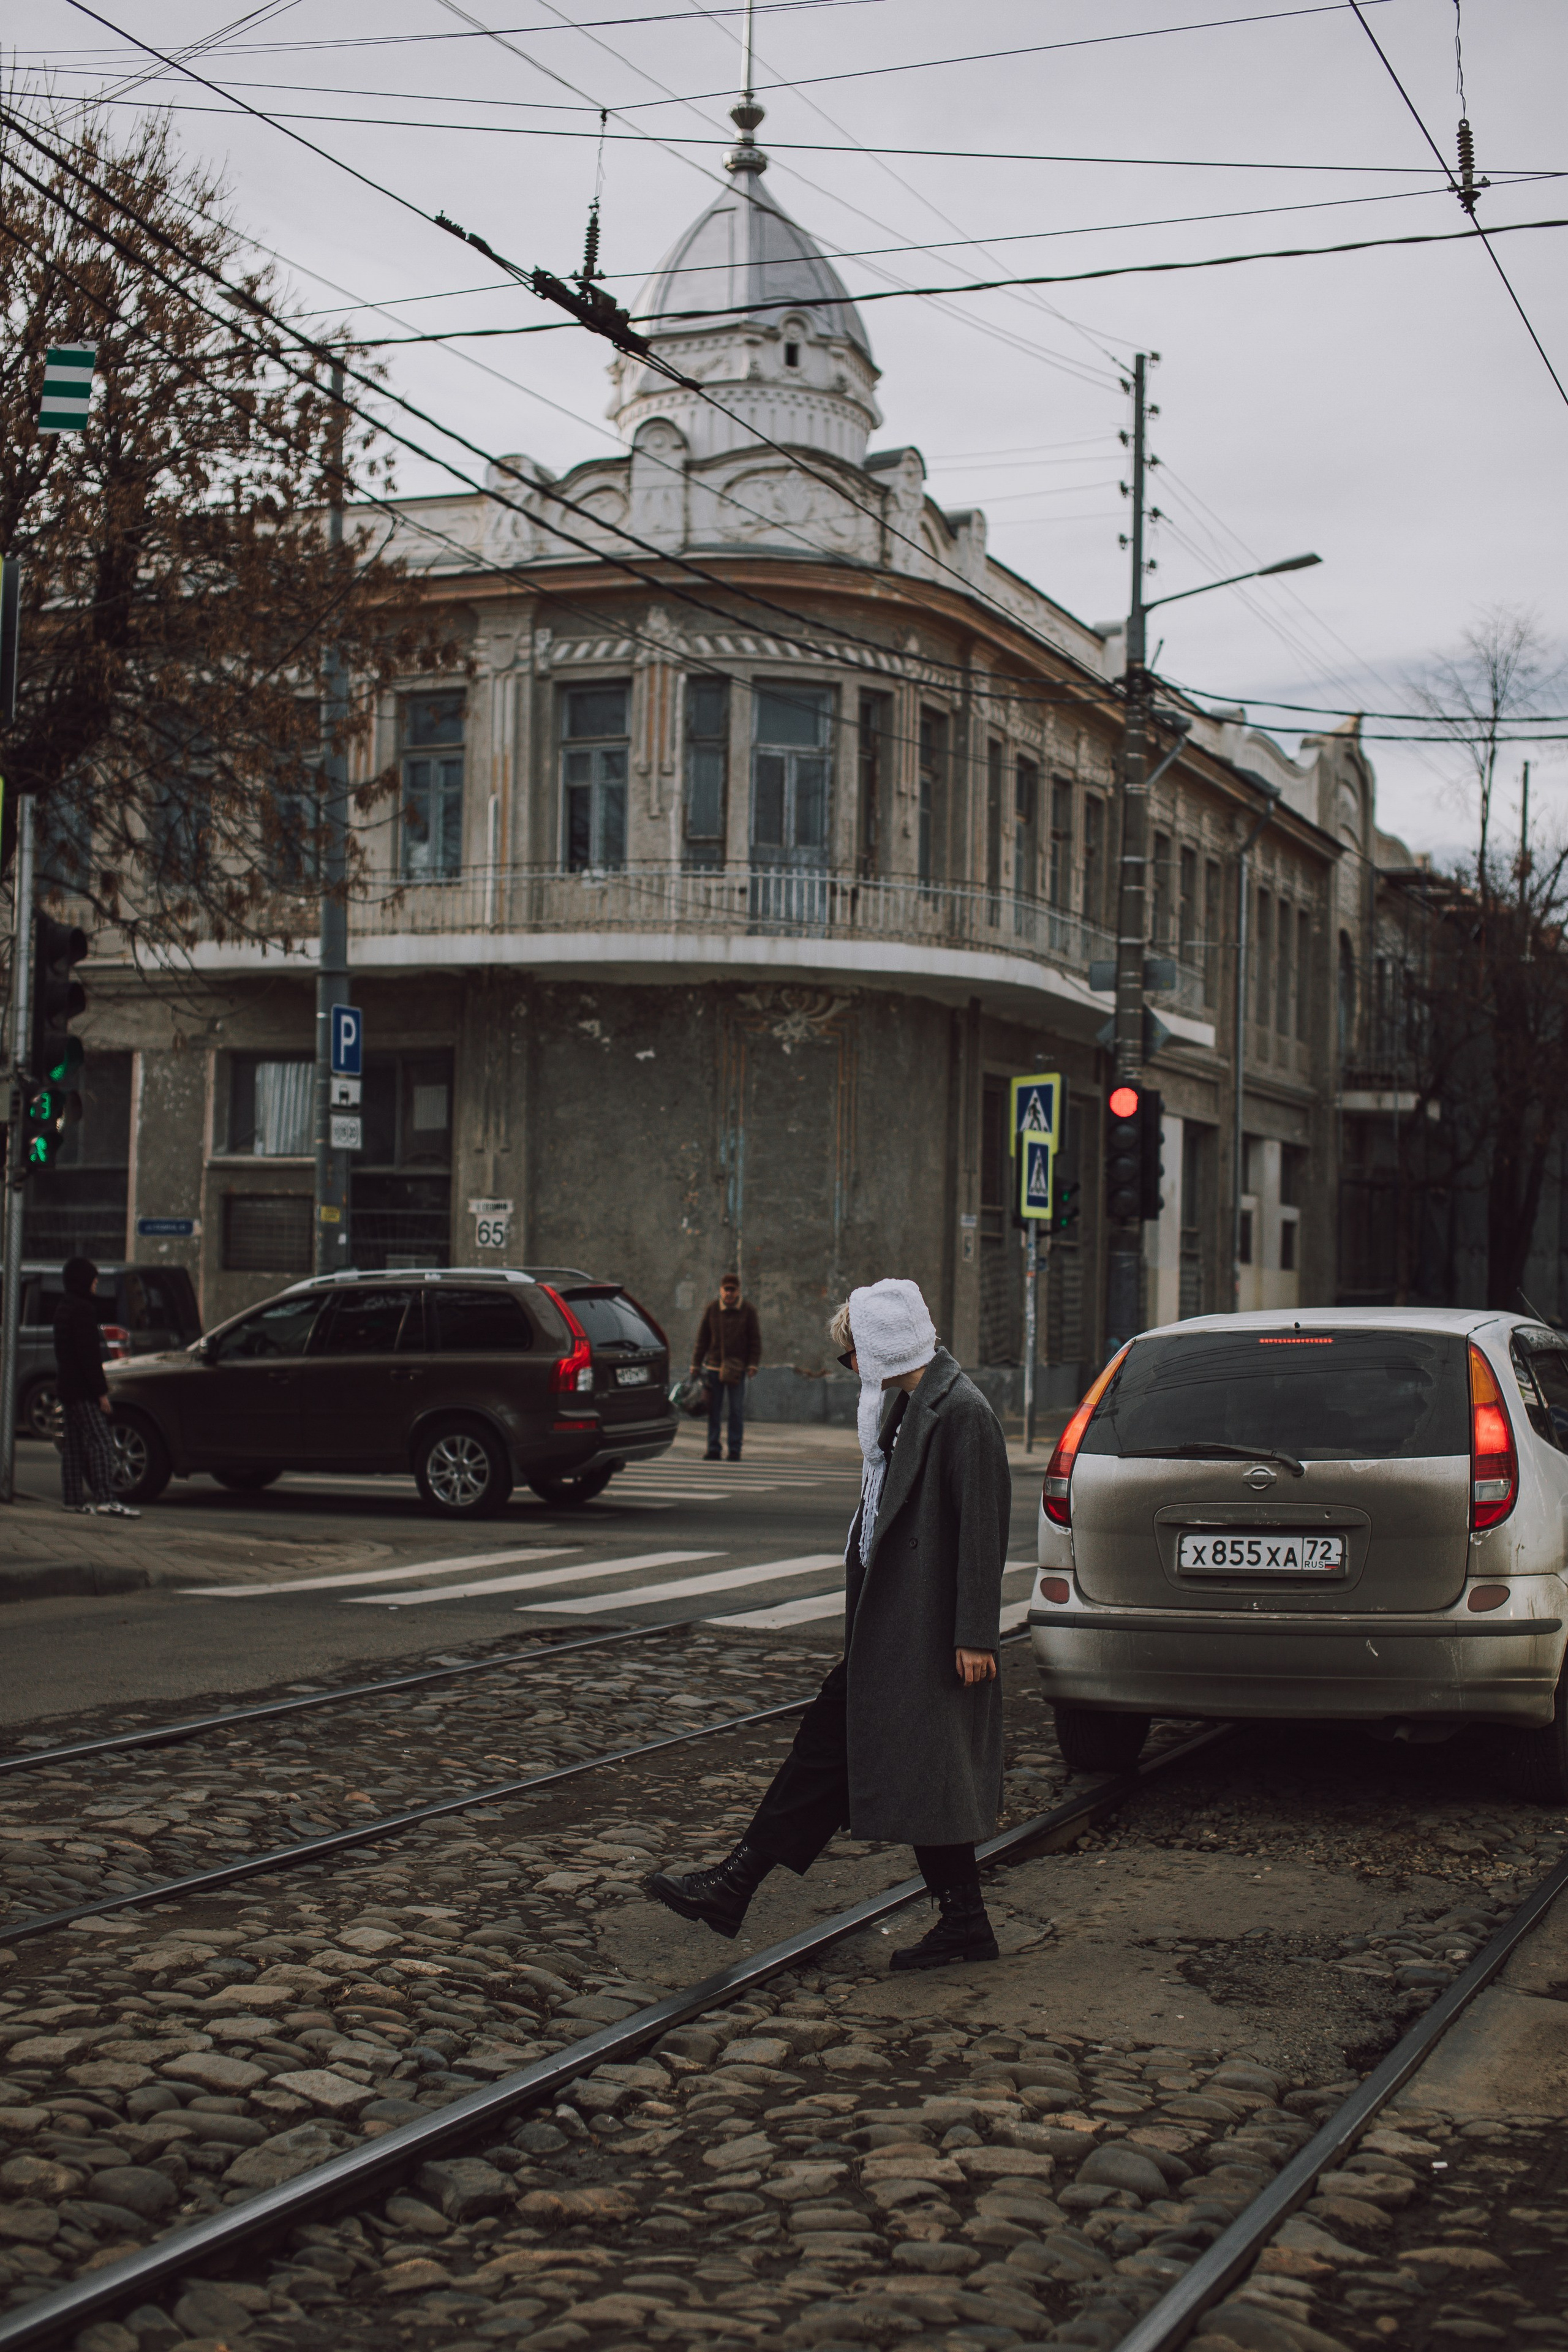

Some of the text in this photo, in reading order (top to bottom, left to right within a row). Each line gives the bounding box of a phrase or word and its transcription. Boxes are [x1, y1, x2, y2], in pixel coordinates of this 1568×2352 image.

[340, 1014, 356, 1065] P
[478, 1221, 503, 1246] 65
[1306, 1540, 1332, 1561] 72
